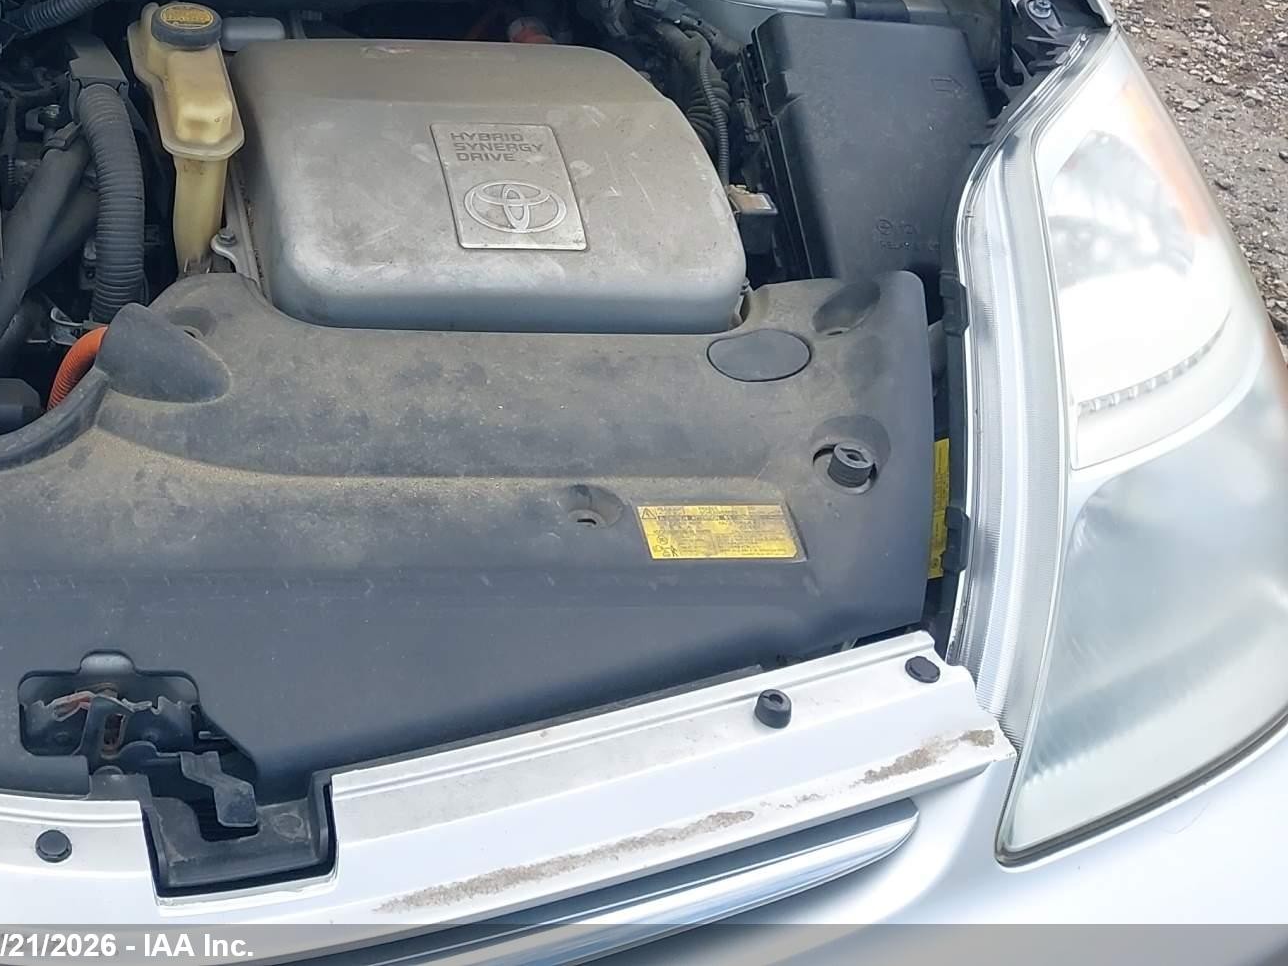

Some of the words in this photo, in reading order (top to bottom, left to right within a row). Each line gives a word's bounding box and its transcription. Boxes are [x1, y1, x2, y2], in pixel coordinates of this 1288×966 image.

[450, 132, 524, 142] HYBRID
[454, 142, 543, 152] SYNERGY
[457, 152, 516, 162] DRIVE
